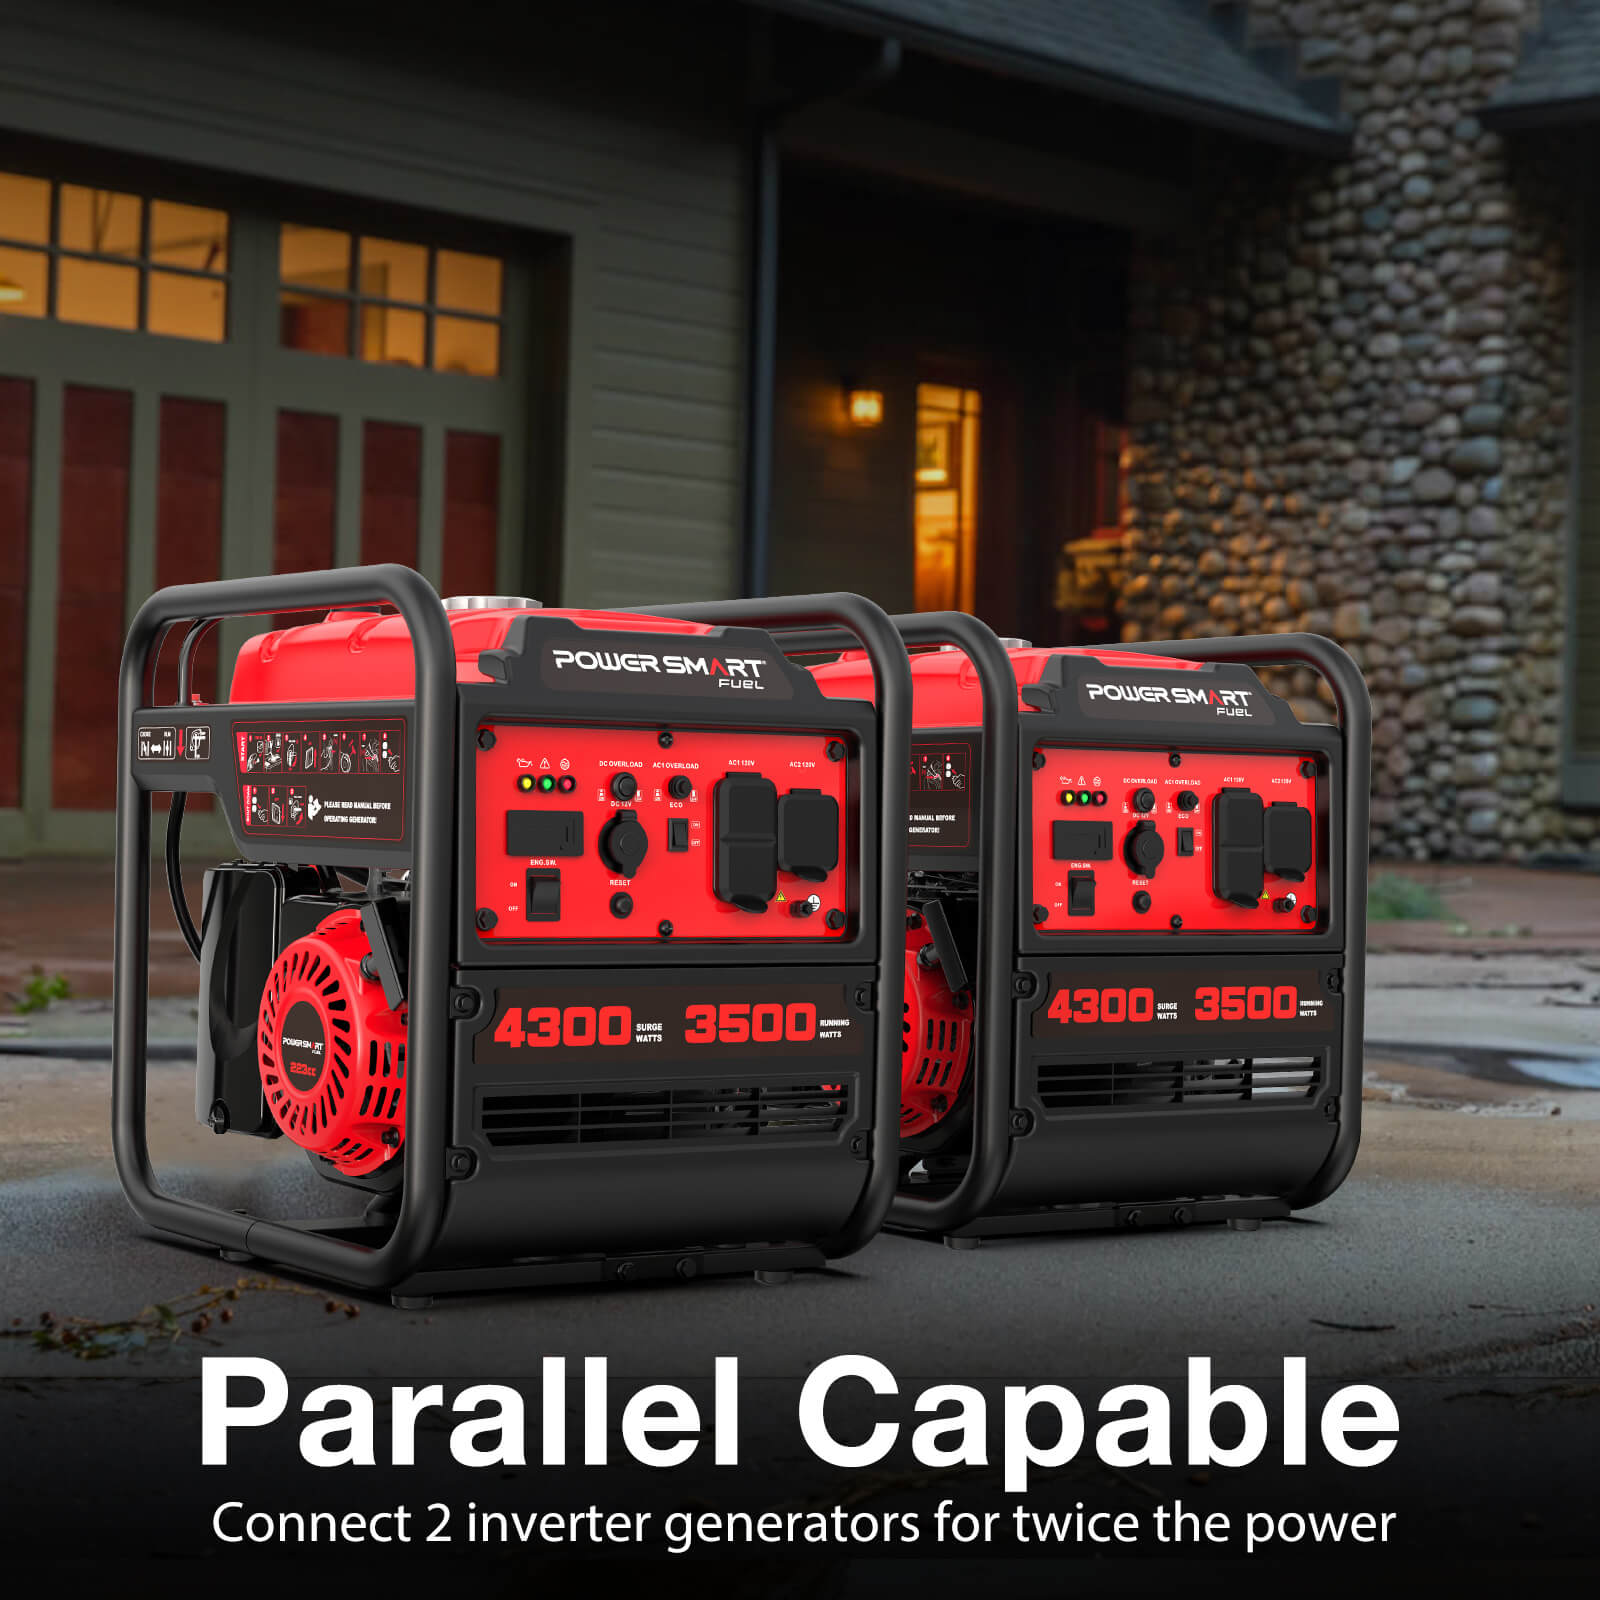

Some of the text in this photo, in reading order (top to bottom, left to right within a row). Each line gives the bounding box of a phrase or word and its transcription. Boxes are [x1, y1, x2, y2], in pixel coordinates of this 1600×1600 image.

[552, 649, 762, 678] POWER SMART
[718, 678, 765, 690] FUEL
[1085, 683, 1250, 706] POWER SMART
[1216, 707, 1253, 717] FUEL
[599, 760, 608, 768] DC
[324, 801, 391, 810] PLEASE READ MANUAL BEFORE
[323, 815, 349, 823] OPERATING
[609, 879, 631, 887] RESET
[1047, 987, 1178, 1024] 4300 SURGE
[1194, 985, 1298, 1021] 3500
[1157, 1012, 1178, 1021] WATTS
[1299, 1010, 1317, 1018] WATTS
[494, 1005, 663, 1048] 4300 SURGE
[684, 1002, 850, 1044] 3500 RUNNING
[635, 1033, 663, 1043] WATTS
[819, 1030, 842, 1039] WATTS
